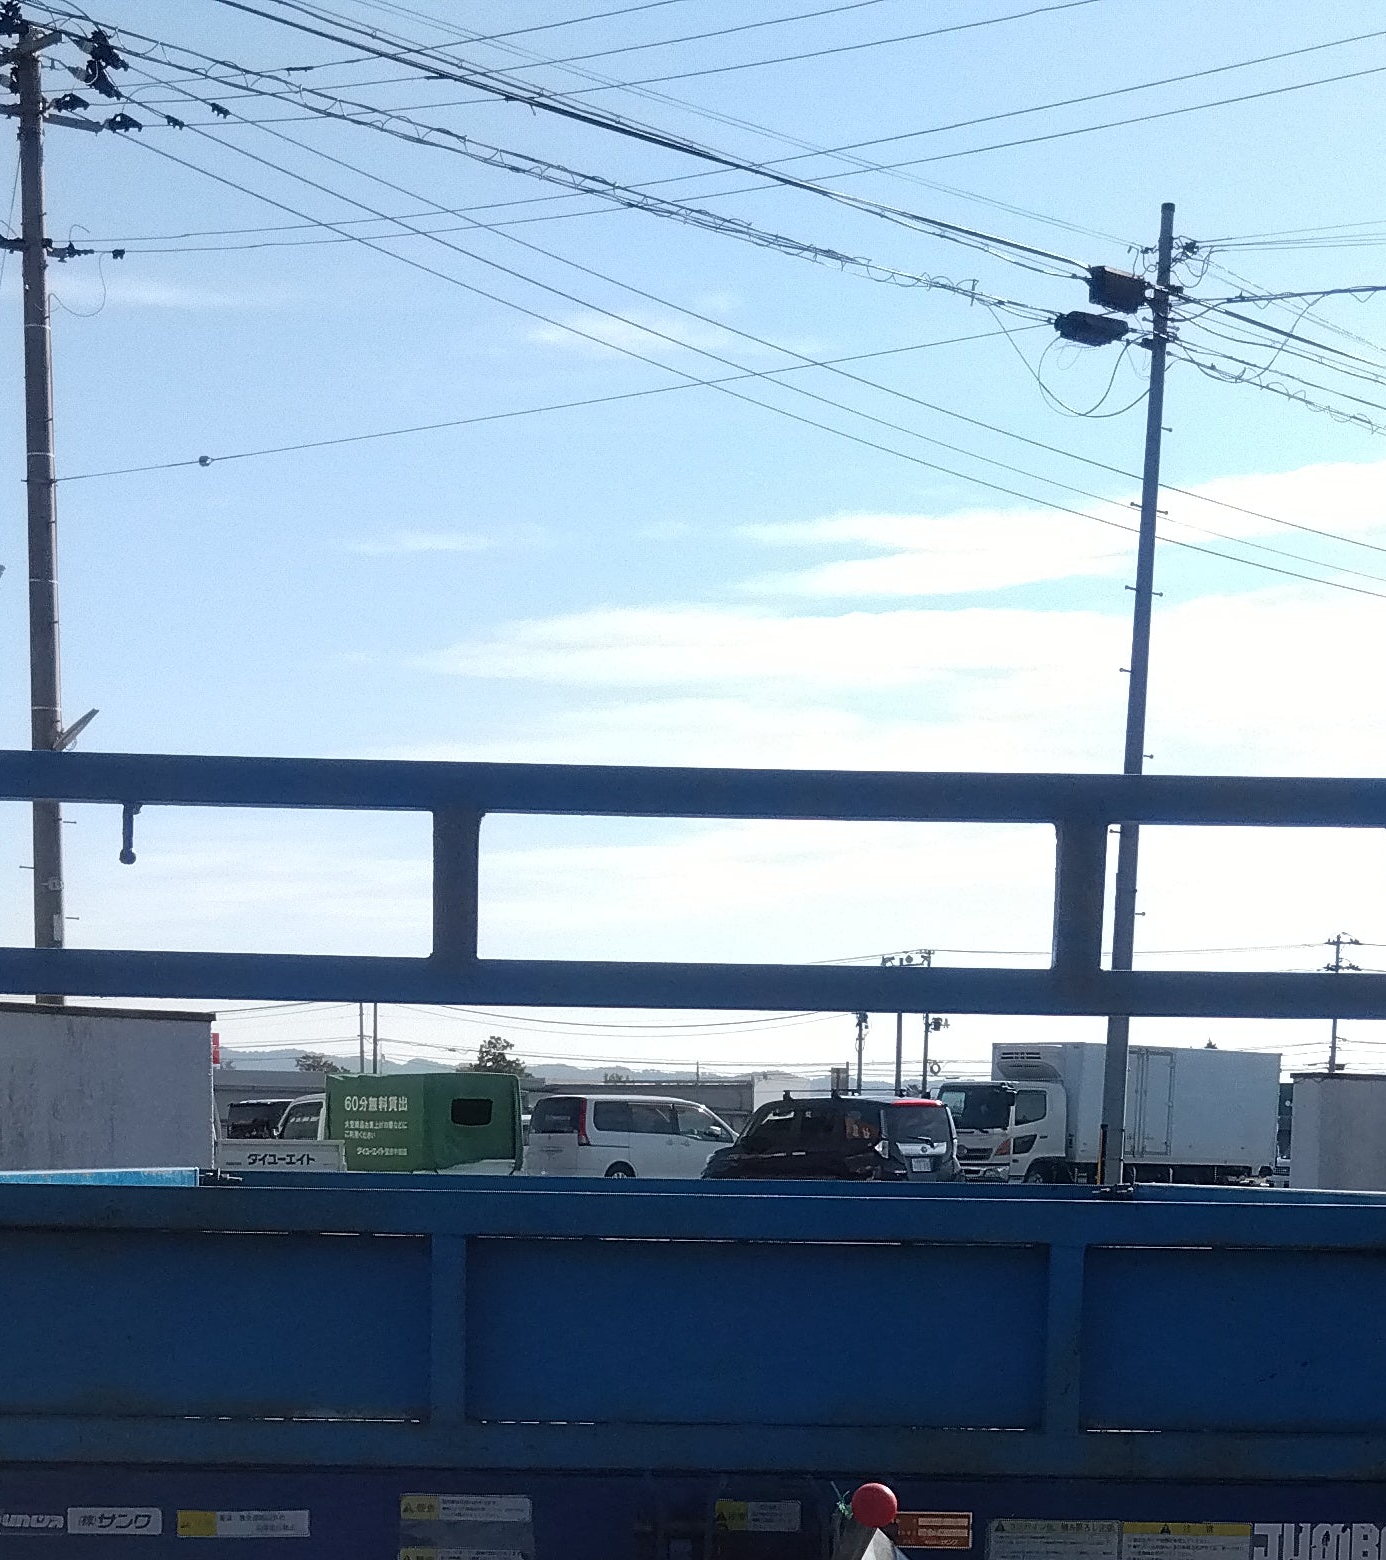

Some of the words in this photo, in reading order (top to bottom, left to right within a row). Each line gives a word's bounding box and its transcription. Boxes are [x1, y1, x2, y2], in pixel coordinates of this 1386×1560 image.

[247, 1153, 316, 1166] ダイユーエイト
